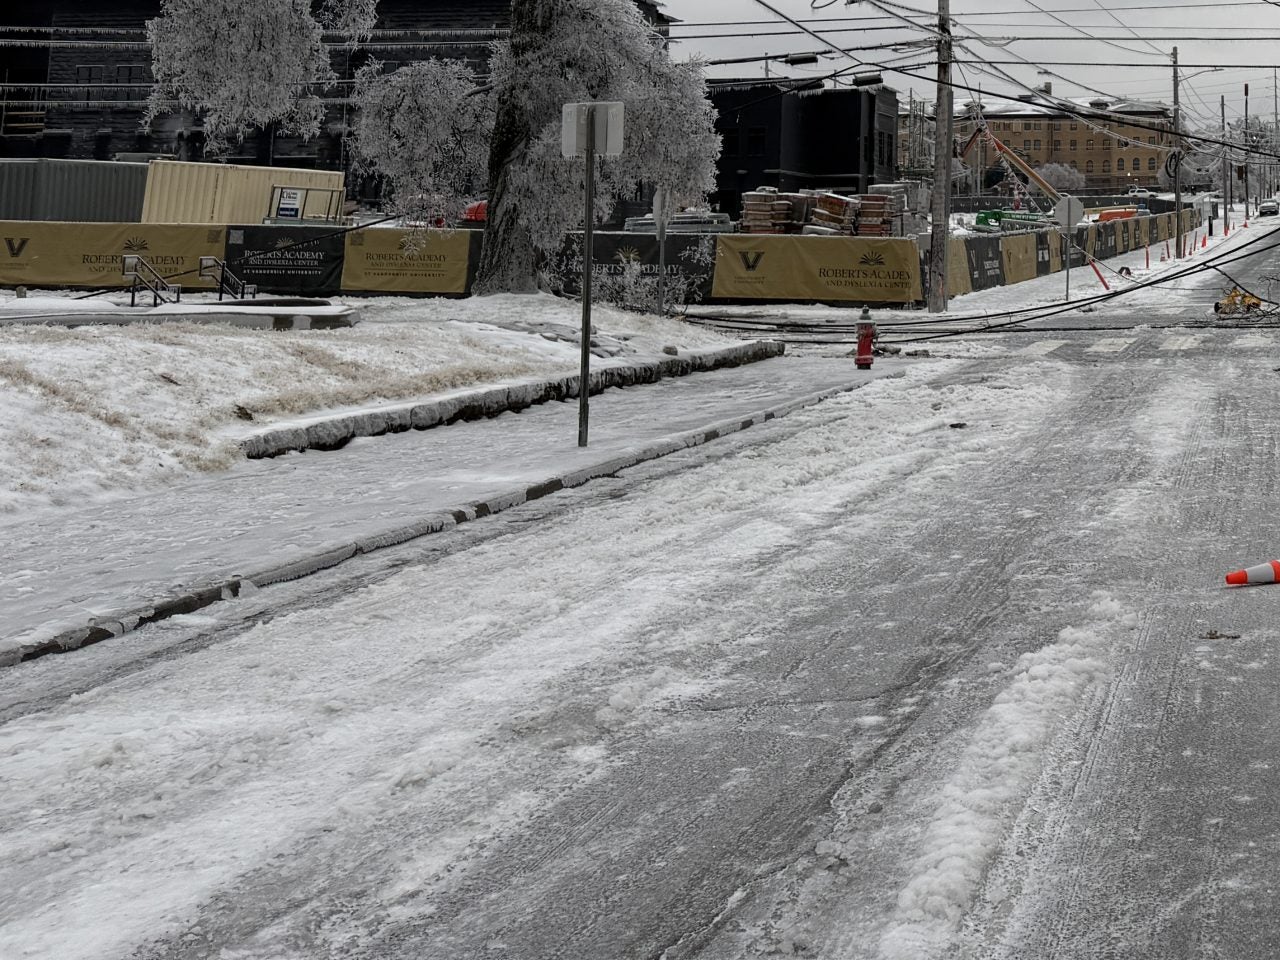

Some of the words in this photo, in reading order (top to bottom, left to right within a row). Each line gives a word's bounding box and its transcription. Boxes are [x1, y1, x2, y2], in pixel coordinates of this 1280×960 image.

[4, 237, 30, 257] V
[82, 254, 123, 264] ROBERT
[144, 255, 185, 266] CADEMY
[282, 250, 325, 260] ACADEMY
[366, 253, 404, 261] ROBERTS
[405, 253, 447, 262] ACADEMY
[738, 251, 766, 271] V
[819, 268, 868, 279] ROBERTS
[844, 280, 882, 288] DYSLEXIA
